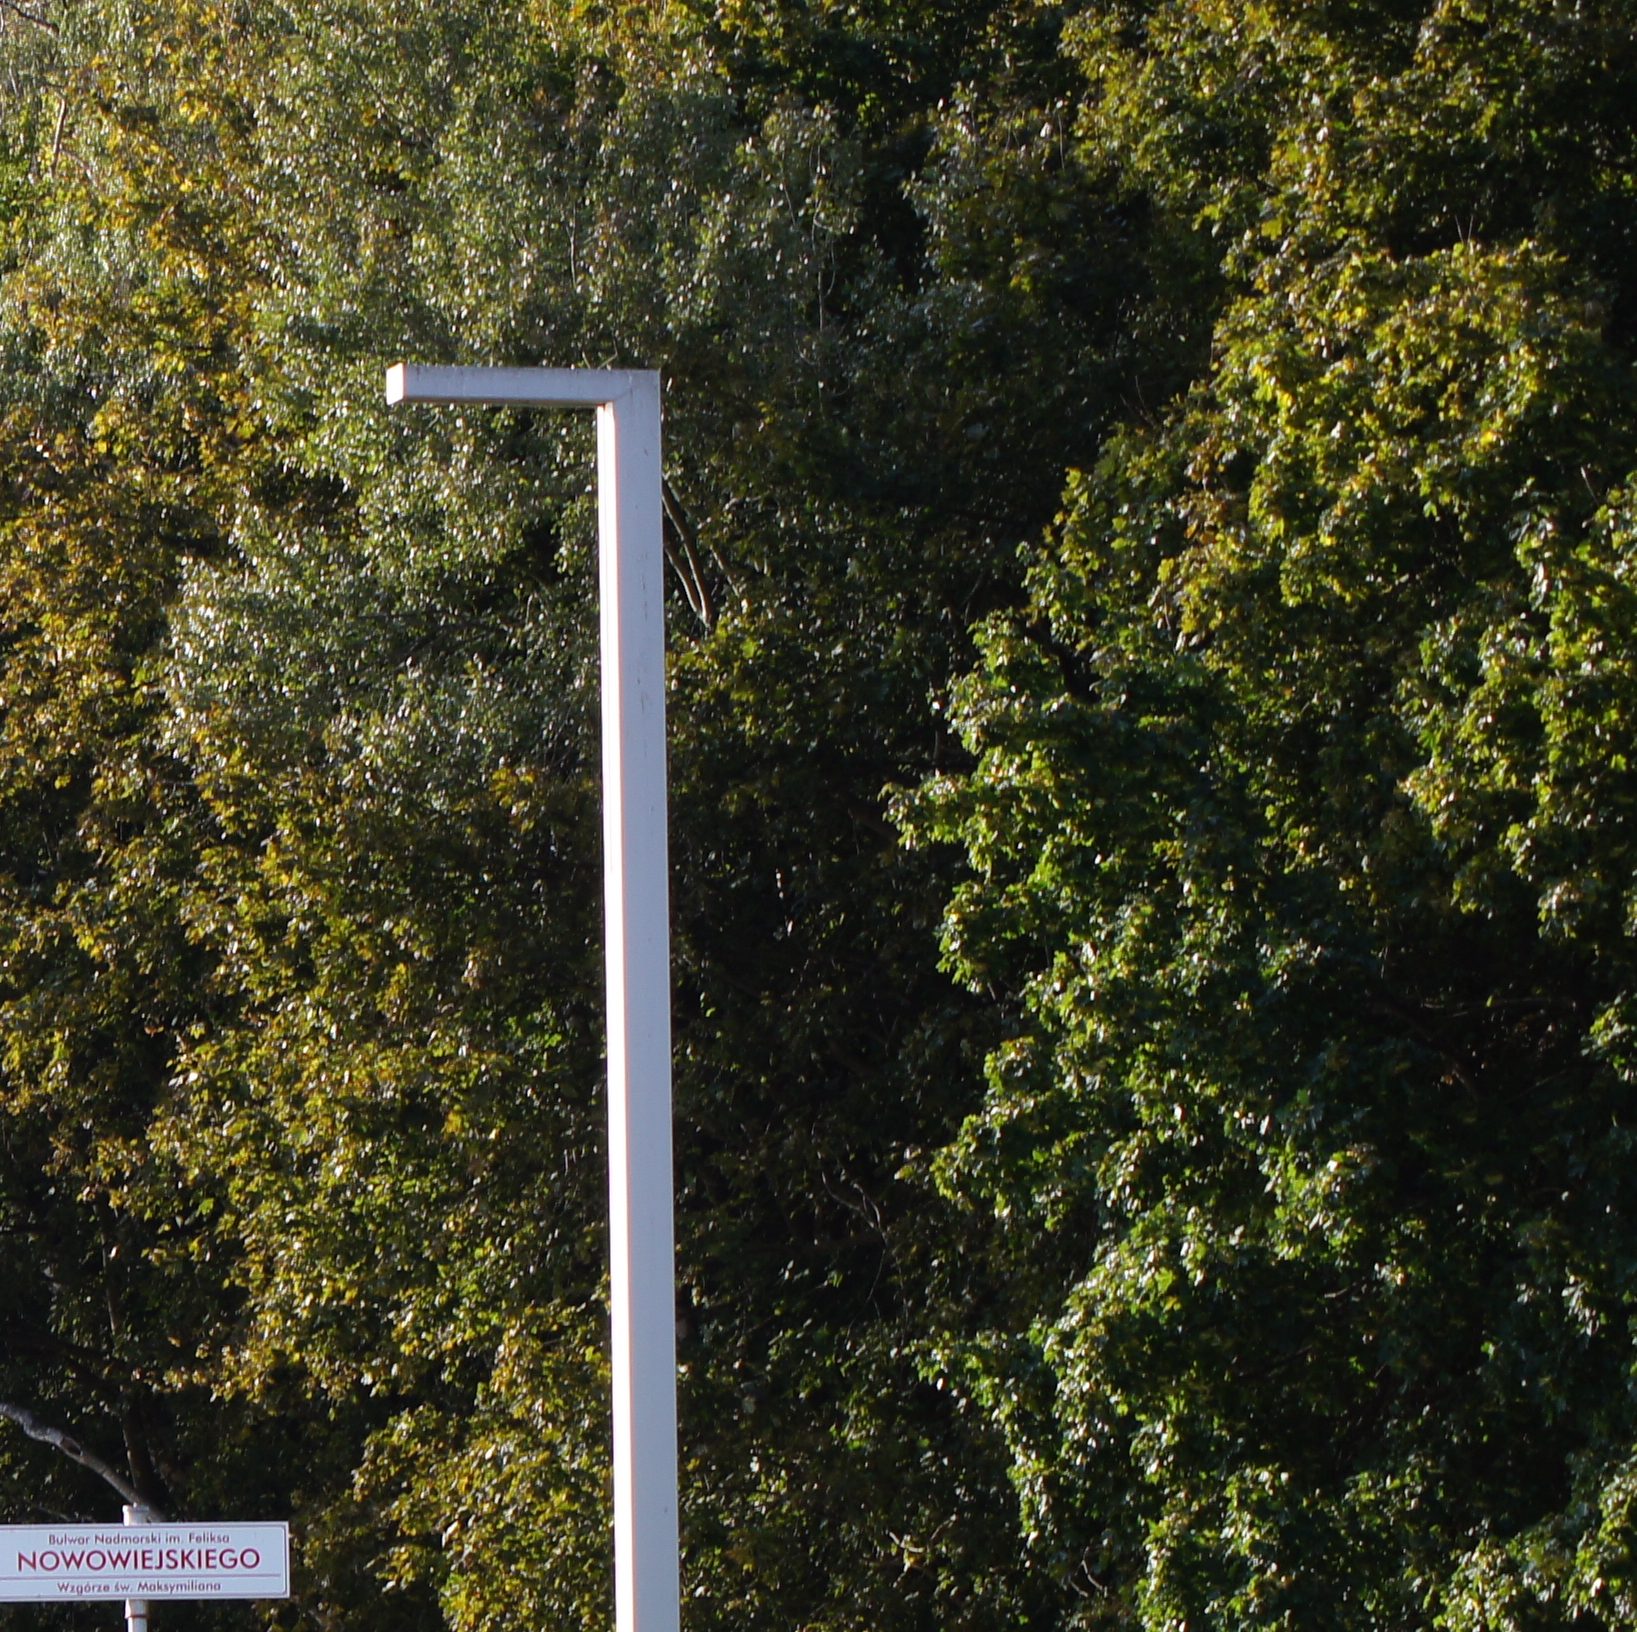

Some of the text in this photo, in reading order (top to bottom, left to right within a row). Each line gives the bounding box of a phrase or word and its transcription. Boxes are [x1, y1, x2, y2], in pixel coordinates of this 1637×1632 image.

[48, 1532, 230, 1545] Bulwar Nadmorski im. Feliksa
[18, 1548, 261, 1572] NOWOWIEJSKIEGO
[57, 1580, 221, 1595] Wzgórze św. Maksymiliana
